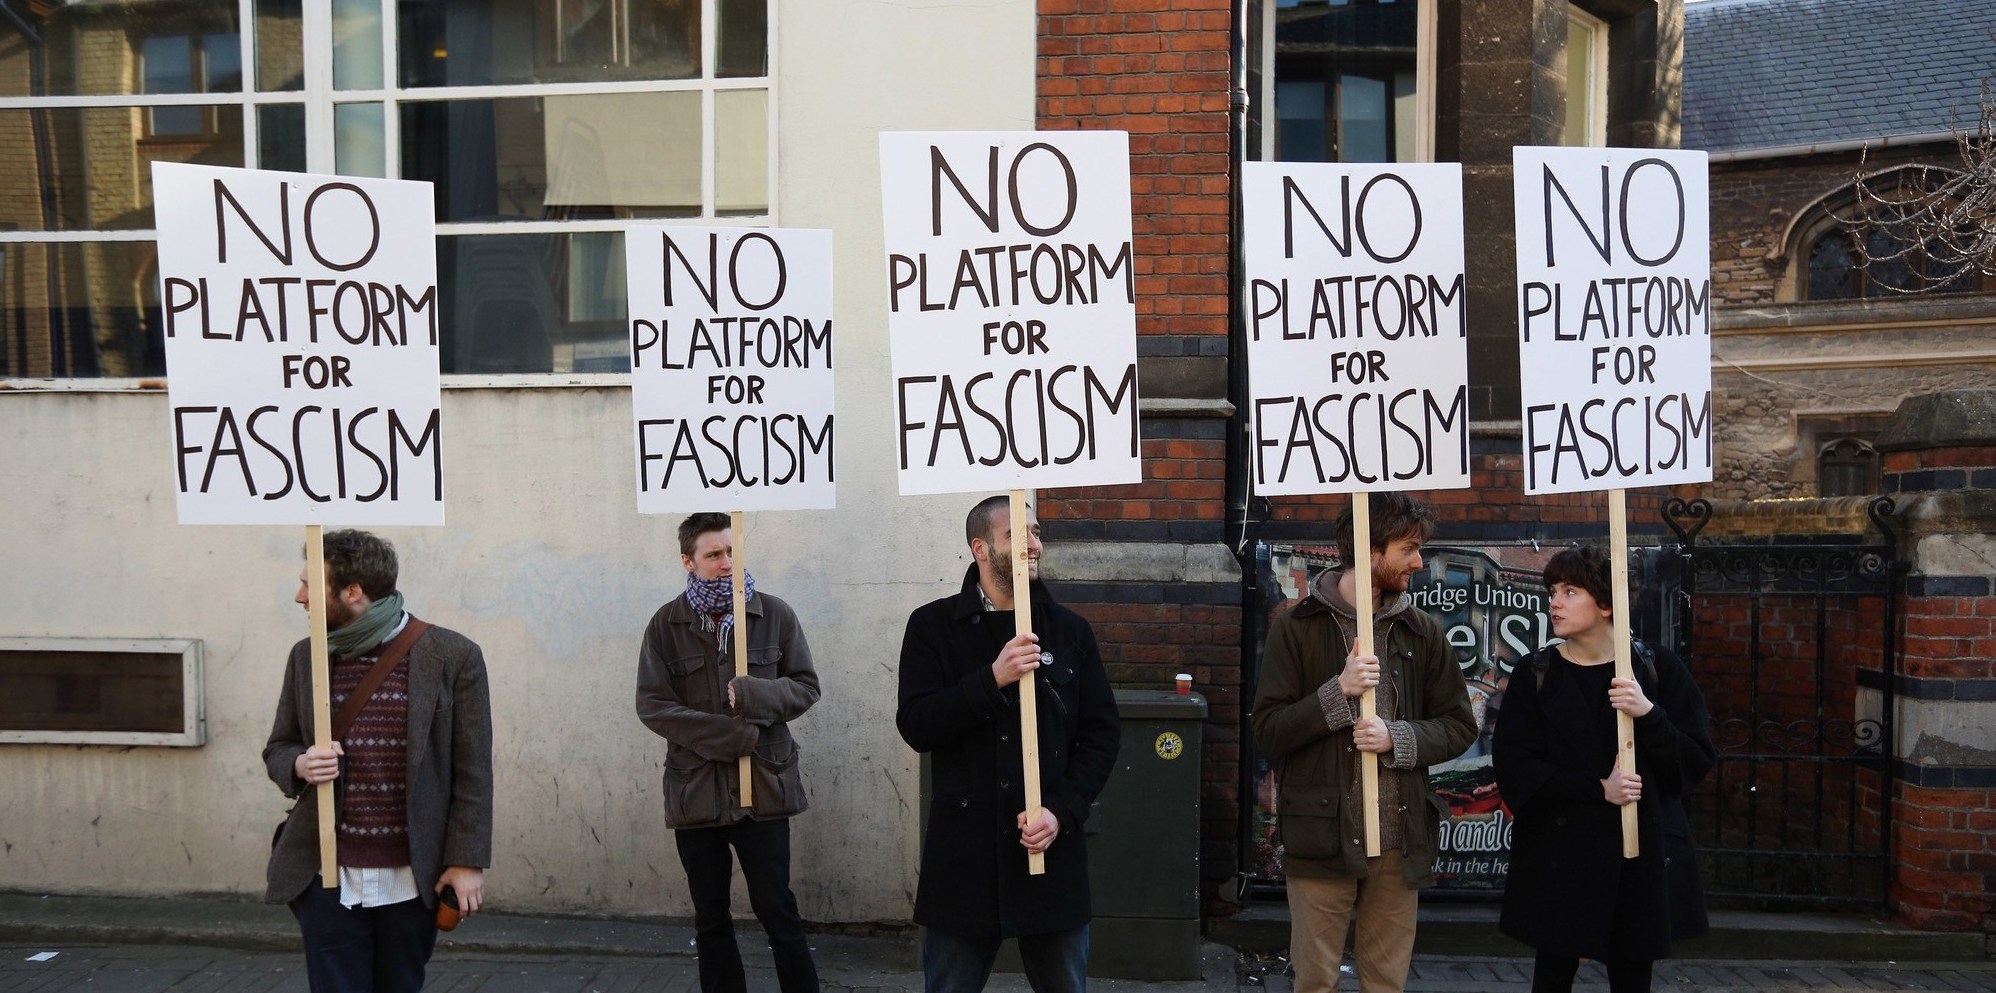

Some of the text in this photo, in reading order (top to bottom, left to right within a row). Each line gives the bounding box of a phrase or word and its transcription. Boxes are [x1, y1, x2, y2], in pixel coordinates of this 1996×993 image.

[930, 142, 1077, 237] NO
[1283, 173, 1422, 264] NO
[1543, 158, 1685, 268] NO
[214, 179, 380, 271] NO
[662, 231, 787, 314] NO
[889, 241, 1135, 312] PLATFORM
[1251, 273, 1466, 341] PLATFORM
[164, 277, 437, 346] PLATFORM
[633, 315, 832, 369] PLATFORM
[983, 320, 1050, 355] FOR
[1523, 276, 1709, 342] PLATFORM
[282, 355, 352, 389] FOR
[708, 375, 765, 404] FOR
[1331, 350, 1390, 385] FOR
[1592, 345, 1656, 385] FOR
[898, 363, 1138, 470] FASCISM
[1255, 384, 1468, 485] FASCISM
[1527, 390, 1711, 490] FASCISM
[174, 405, 442, 502] FASCISM
[638, 413, 834, 491] FASCISM
[1475, 583, 1541, 612] Union
[1452, 809, 1504, 852] and
[1446, 858, 1461, 873] in
[1464, 857, 1489, 874] the
